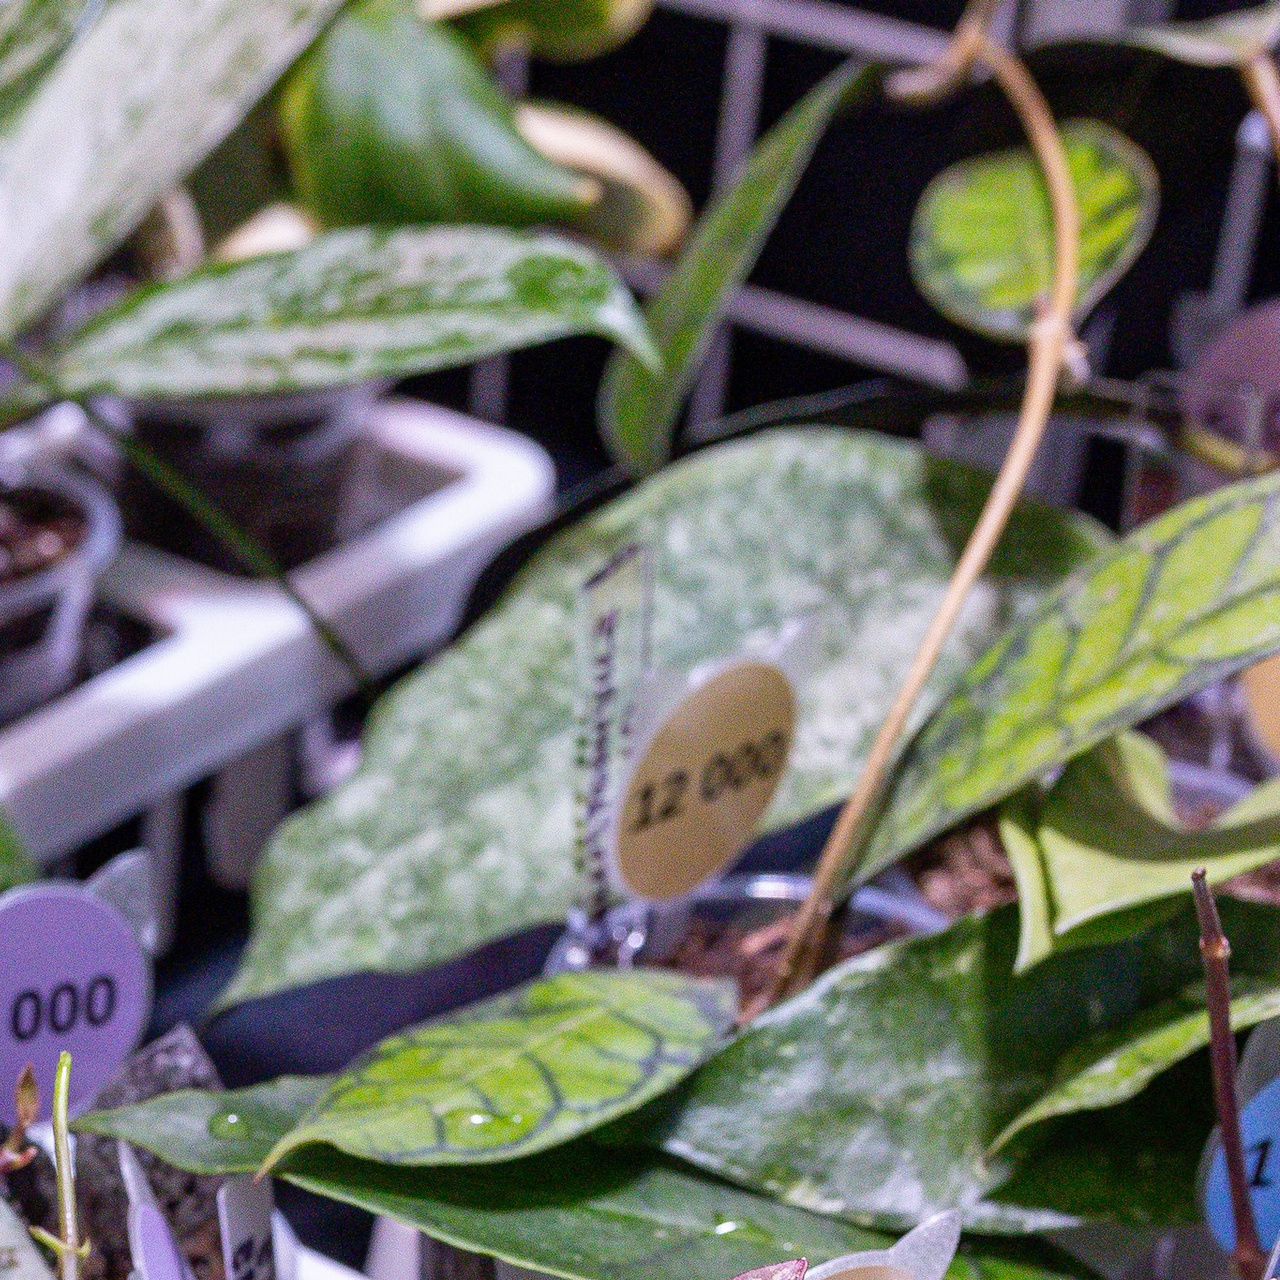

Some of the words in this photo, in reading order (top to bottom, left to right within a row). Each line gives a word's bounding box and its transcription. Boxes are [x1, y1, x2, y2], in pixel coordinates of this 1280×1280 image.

[627, 767, 689, 835] 12
[697, 728, 791, 803] 000
[10, 972, 117, 1043] 000
